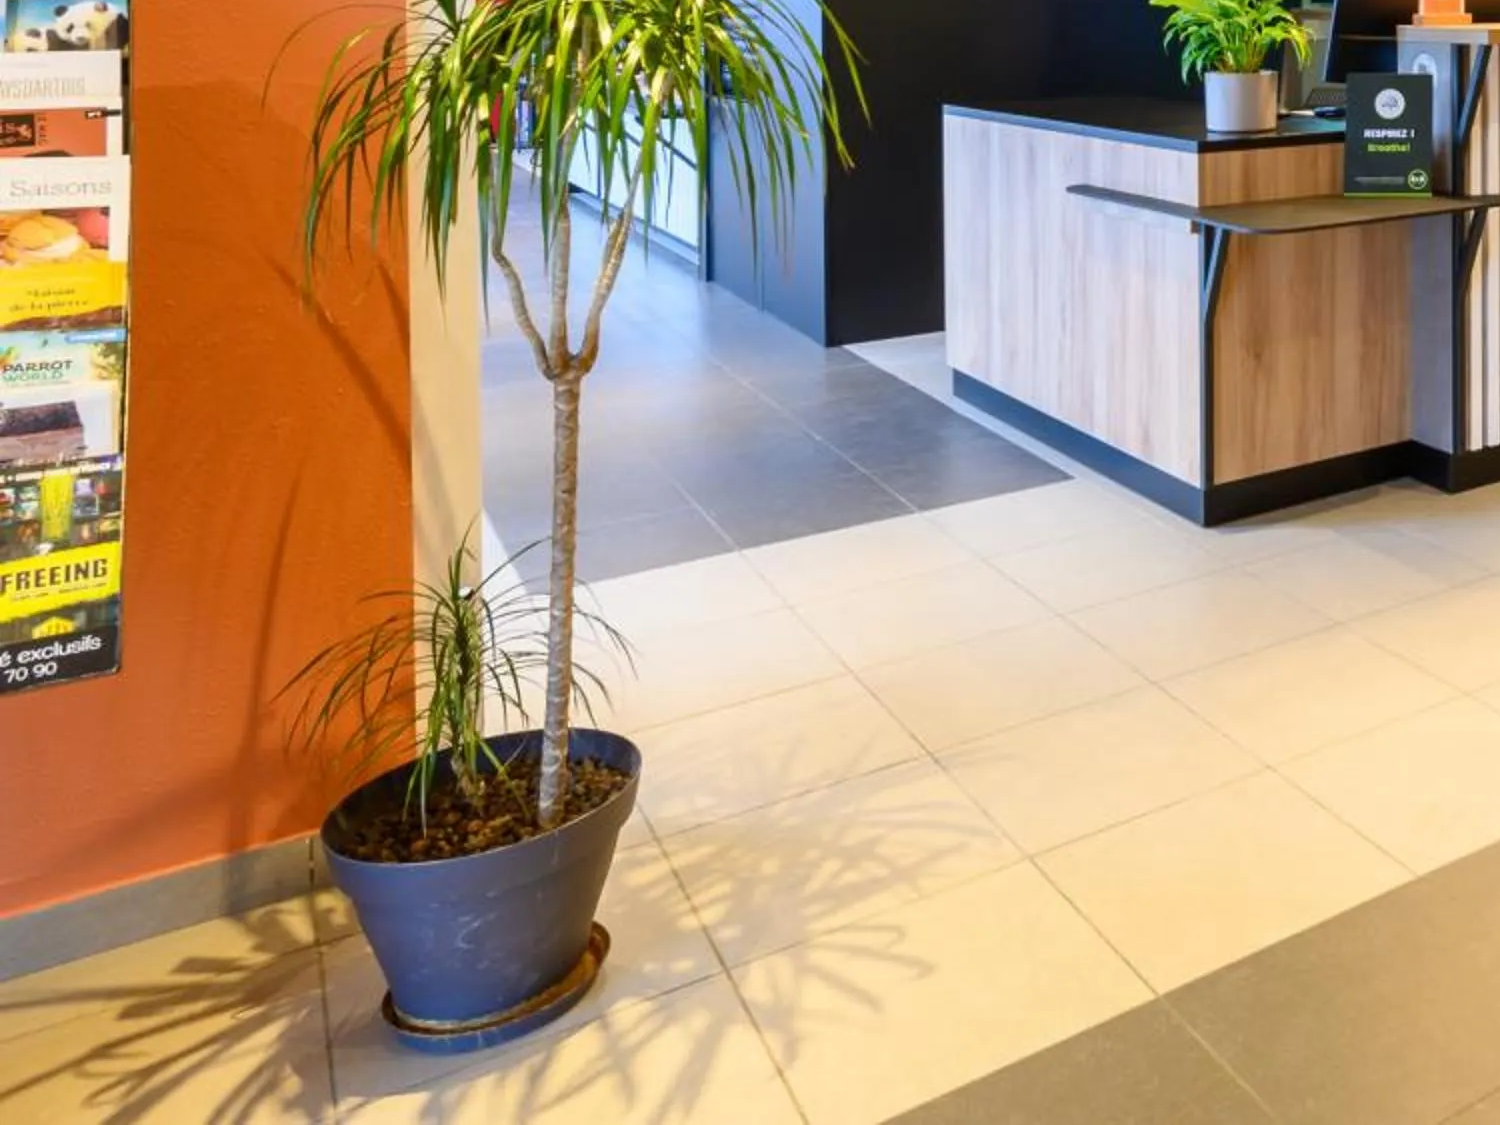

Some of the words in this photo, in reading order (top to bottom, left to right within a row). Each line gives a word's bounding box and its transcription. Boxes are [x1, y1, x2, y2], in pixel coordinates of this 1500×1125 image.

[10, 179, 111, 197] Saisons
[3, 360, 73, 373] PARROT
[17, 635, 102, 664] exclusifs
[33, 661, 58, 678] 90
